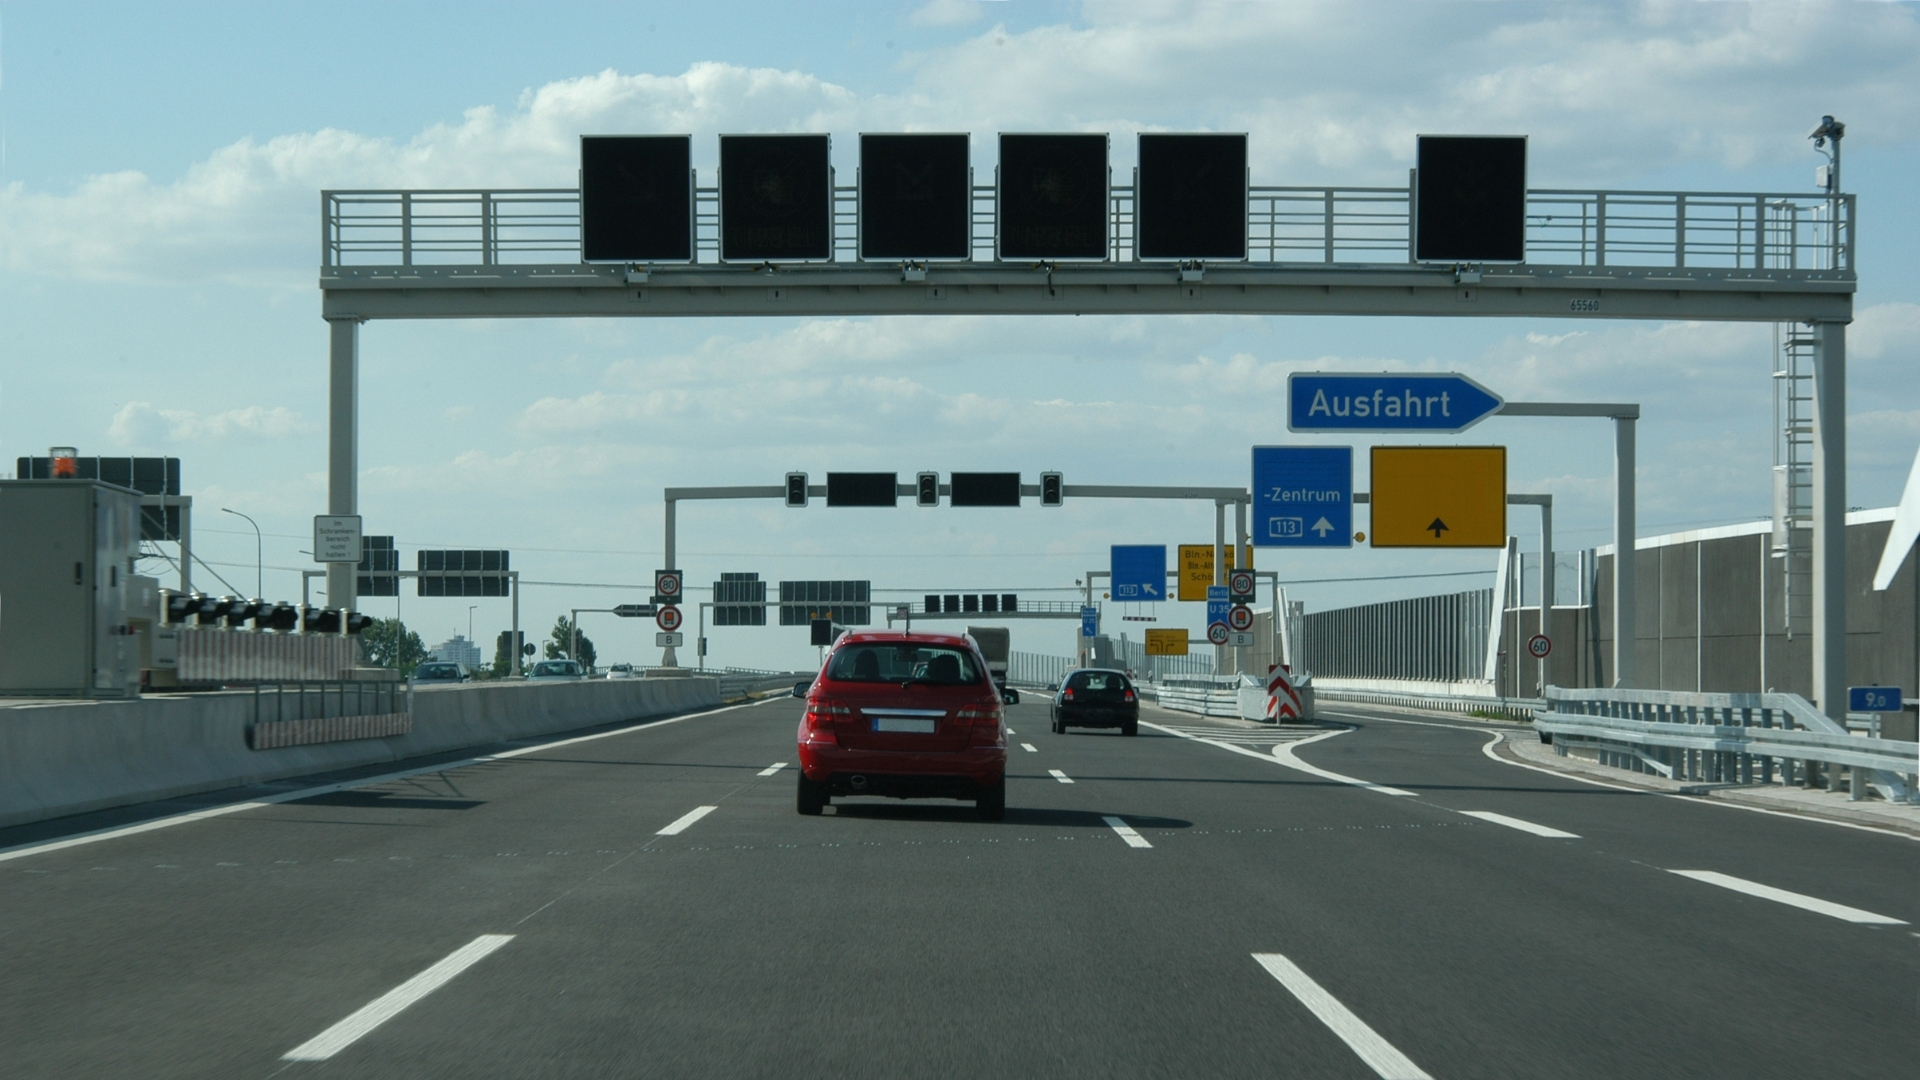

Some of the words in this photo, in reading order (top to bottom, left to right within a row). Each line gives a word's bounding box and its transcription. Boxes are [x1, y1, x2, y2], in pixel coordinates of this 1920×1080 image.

[1570, 299, 1599, 311] 65560
[1308, 388, 1450, 417] Ausfahrt
[1264, 487, 1341, 502] -Zentrum
[1276, 521, 1296, 534] 113
[663, 580, 674, 590] 80
[1236, 579, 1248, 589] 80
[1122, 586, 1134, 595] 113
[1209, 605, 1216, 614] U
[1219, 605, 1230, 614] 35
[1212, 628, 1226, 639] 60
[666, 635, 673, 644] B
[1237, 635, 1244, 644] B
[1533, 641, 1547, 652] 60
[1865, 692, 1887, 708] 9.0
